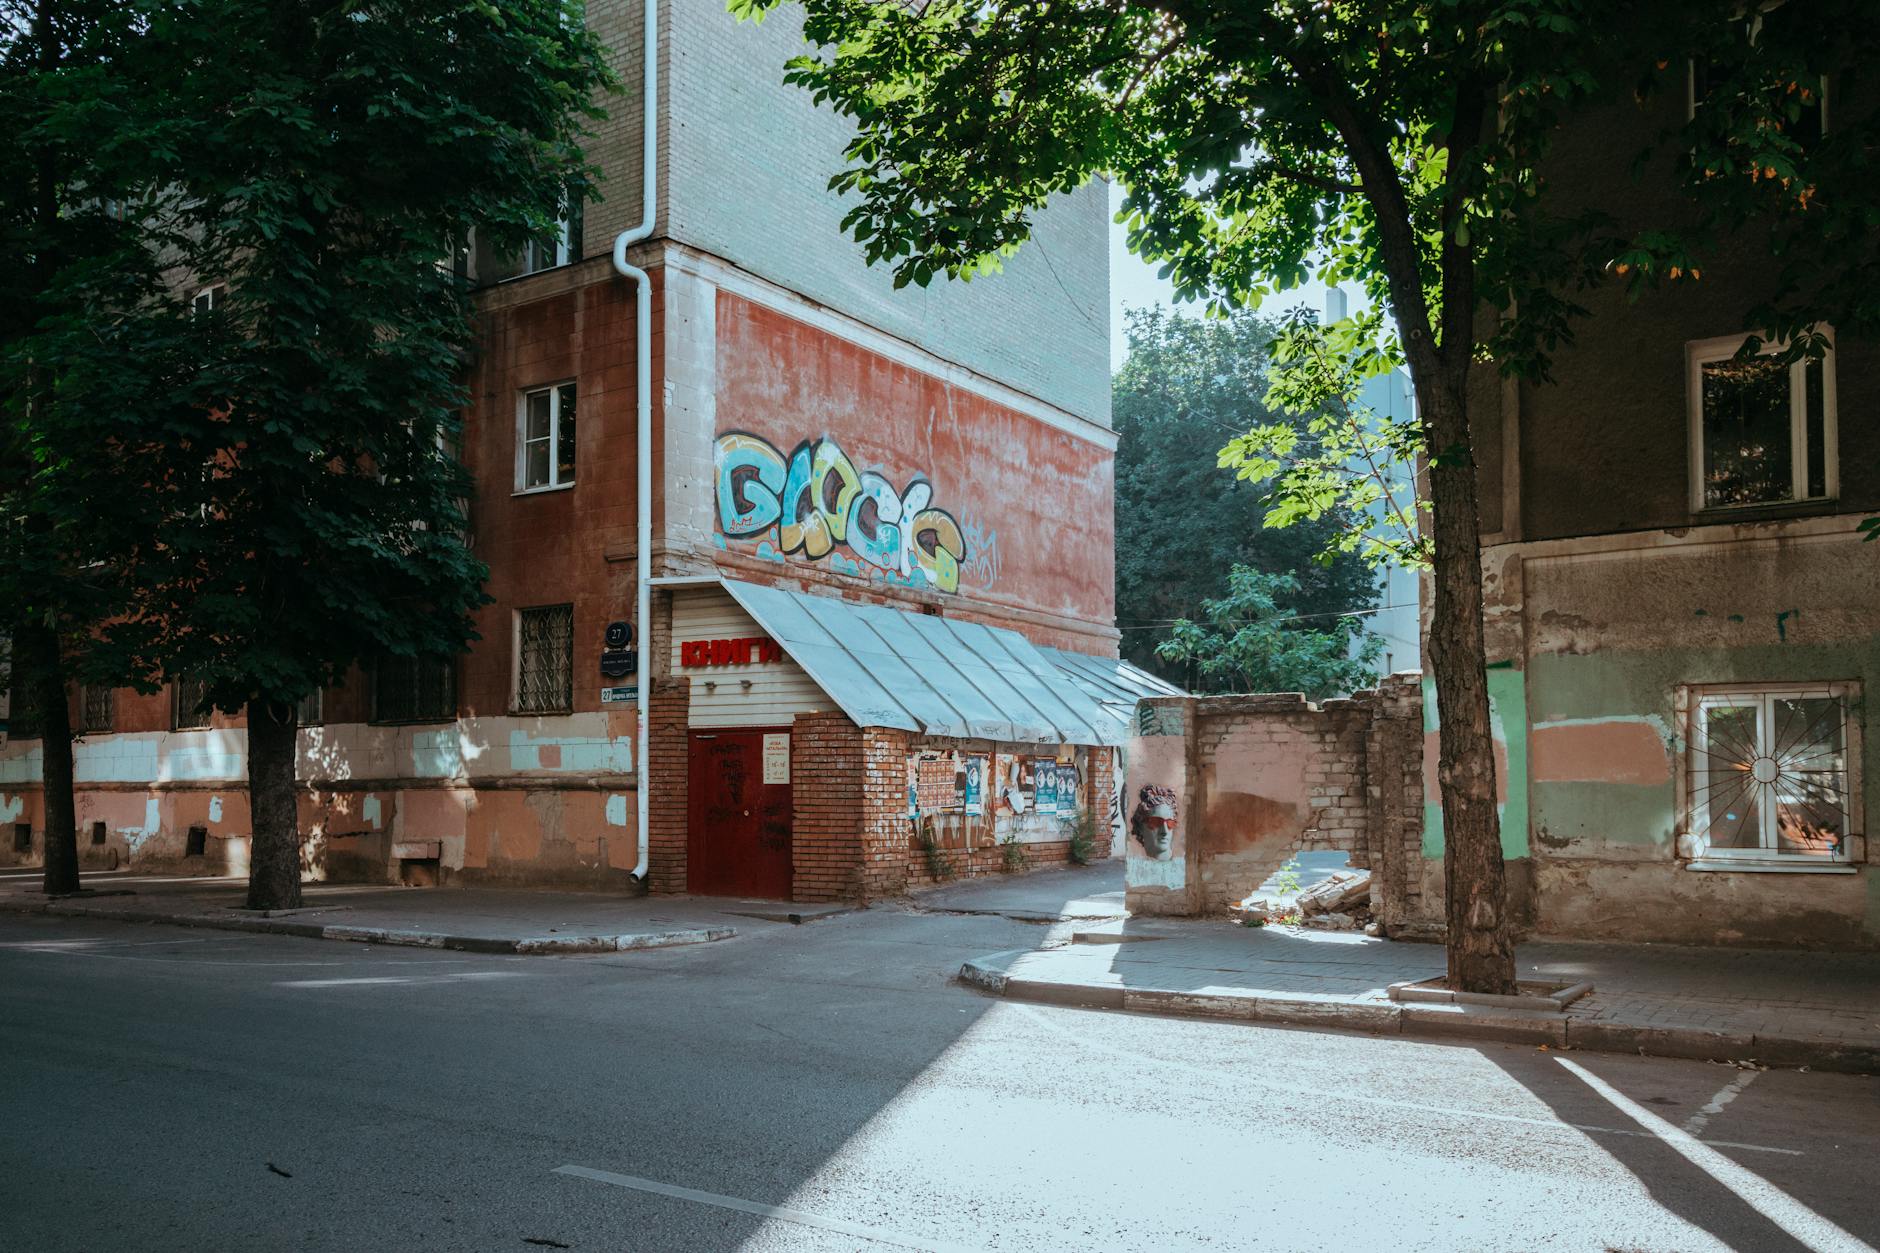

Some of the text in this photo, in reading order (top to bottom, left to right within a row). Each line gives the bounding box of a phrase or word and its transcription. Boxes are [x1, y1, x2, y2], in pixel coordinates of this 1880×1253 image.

[611, 628, 622, 639] 27
[681, 636, 783, 667] КНИГИ
[602, 690, 611, 700] 27
